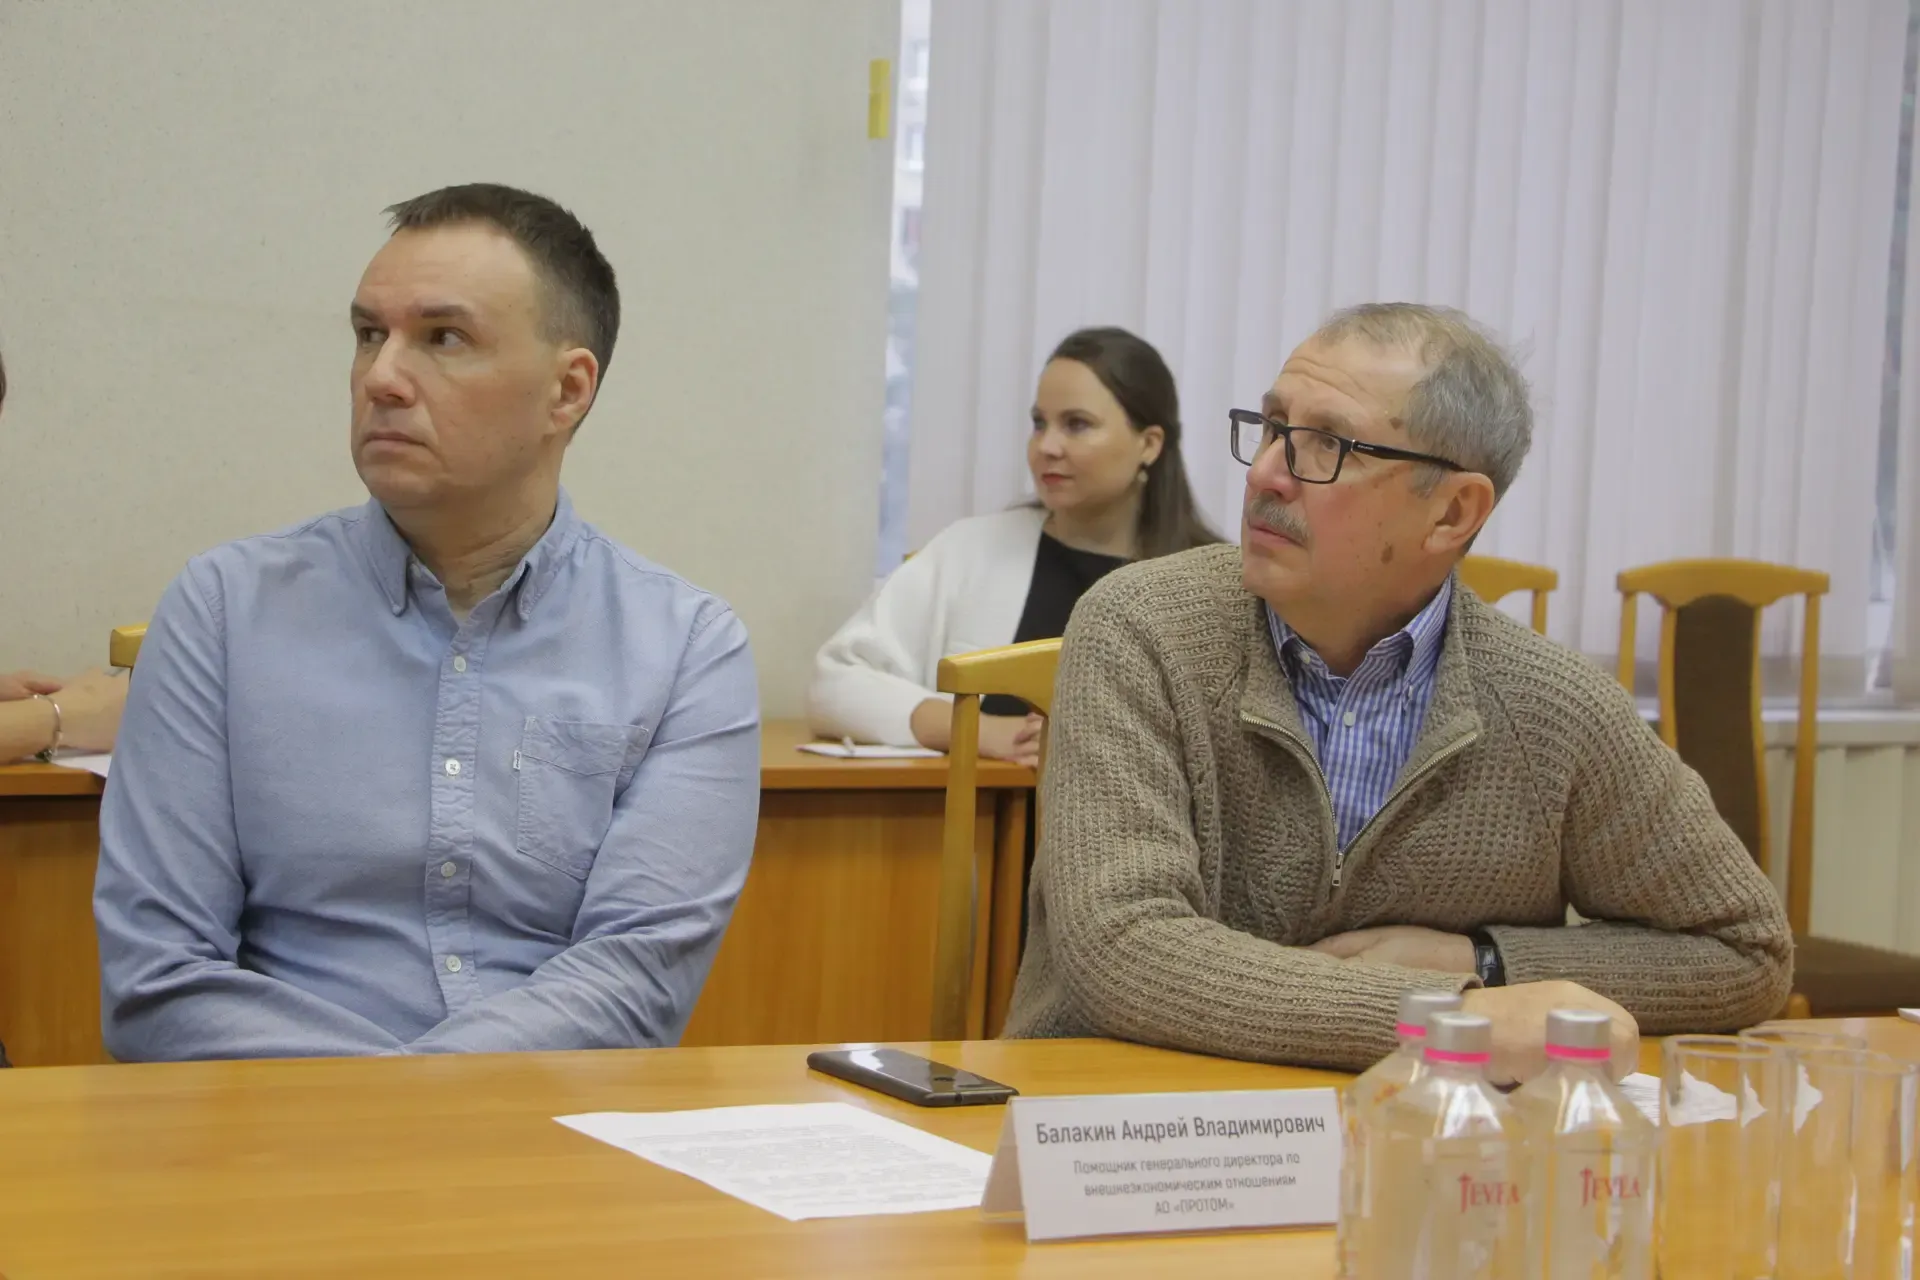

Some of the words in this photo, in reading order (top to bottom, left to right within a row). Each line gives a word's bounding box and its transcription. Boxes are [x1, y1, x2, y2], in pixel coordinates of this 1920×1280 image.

[1036, 1122, 1116, 1144] Балакин
[1122, 1116, 1188, 1143] Андрей
[1193, 1116, 1325, 1139] Владимирович
[1074, 1160, 1138, 1174] Помощник
[1140, 1156, 1220, 1172] генерального
[1223, 1153, 1283, 1169] директора
[1286, 1152, 1300, 1164] по
[1084, 1179, 1222, 1196] внешнеэкономическим
[1225, 1175, 1296, 1189] отношениям
[1155, 1200, 1170, 1216] АО
